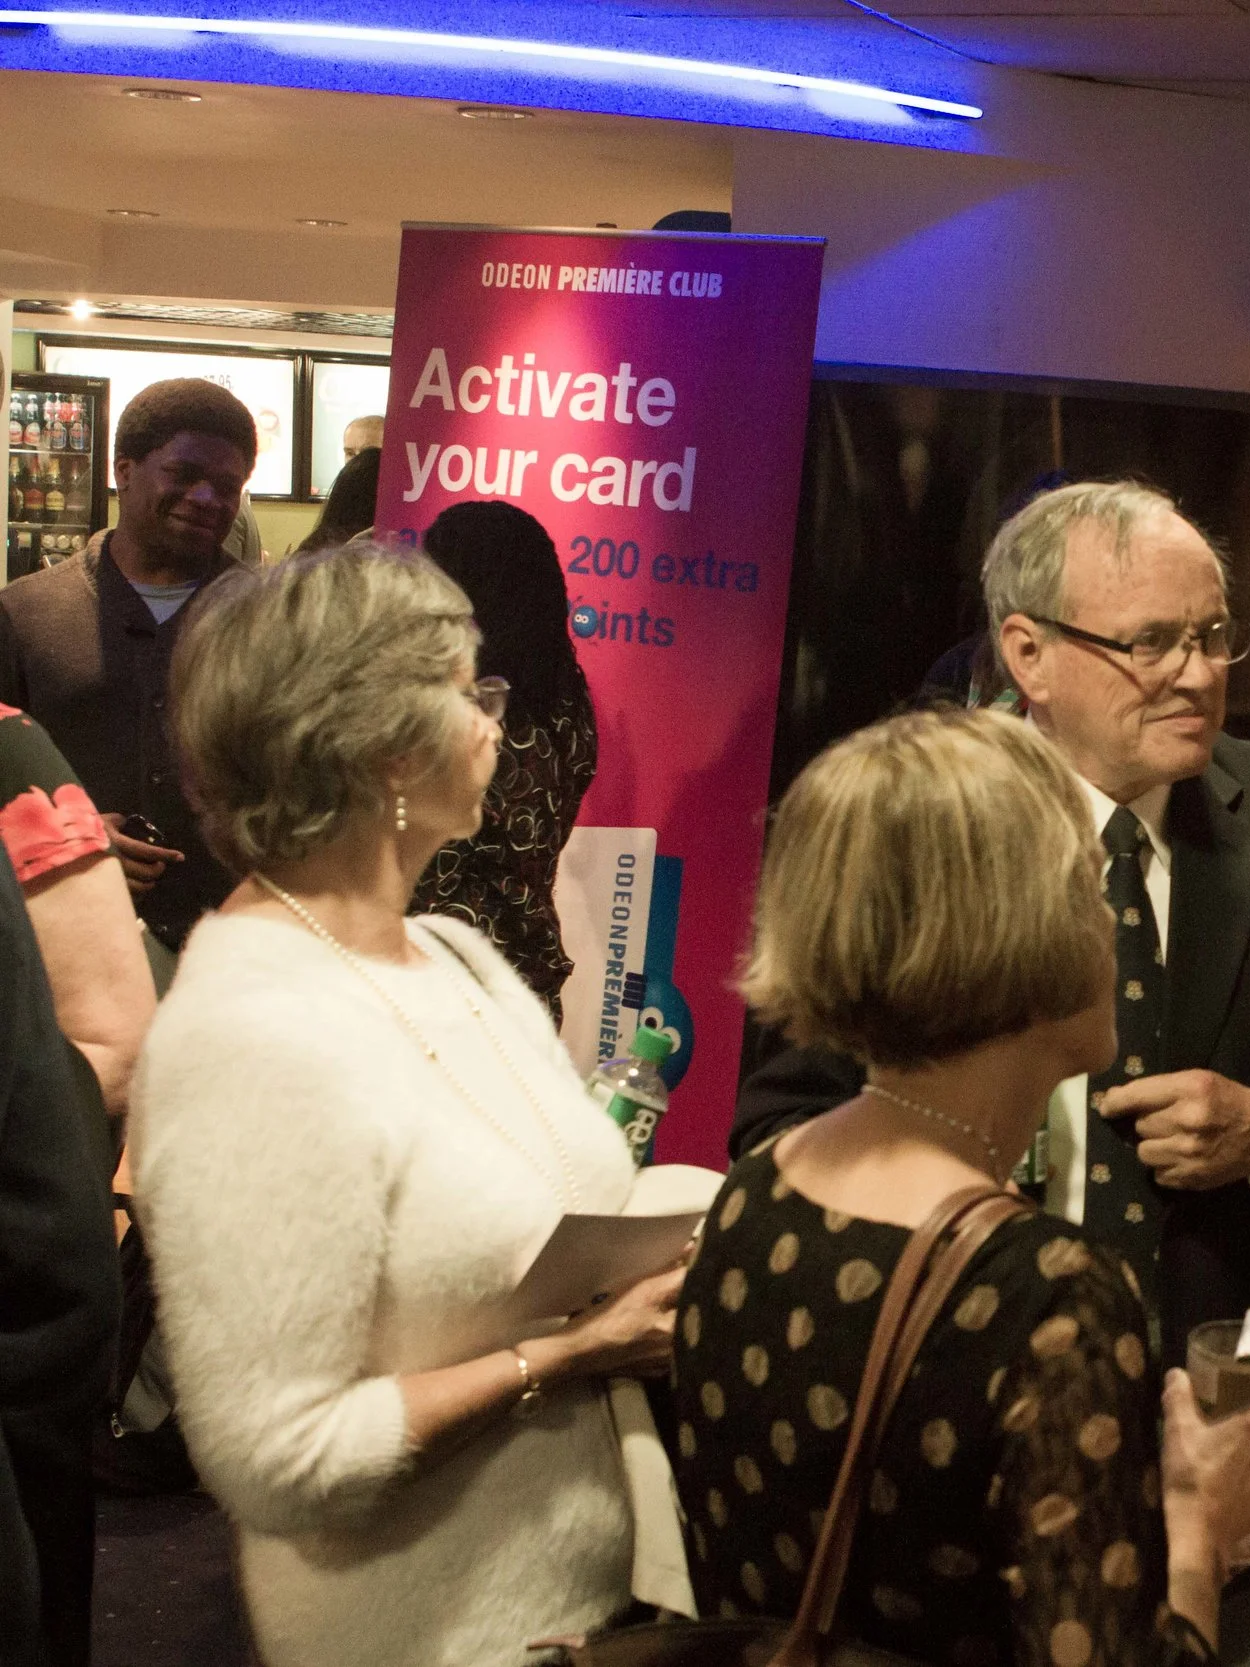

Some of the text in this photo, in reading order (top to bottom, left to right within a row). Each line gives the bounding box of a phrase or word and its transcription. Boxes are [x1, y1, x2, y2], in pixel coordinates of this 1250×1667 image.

[481, 262, 723, 299] ODEON PREMIÈRE CLUB
[409, 347, 677, 428] Activate
[403, 441, 697, 513] your card
[567, 535, 760, 593] 200 extra
[566, 600, 676, 647] oints
